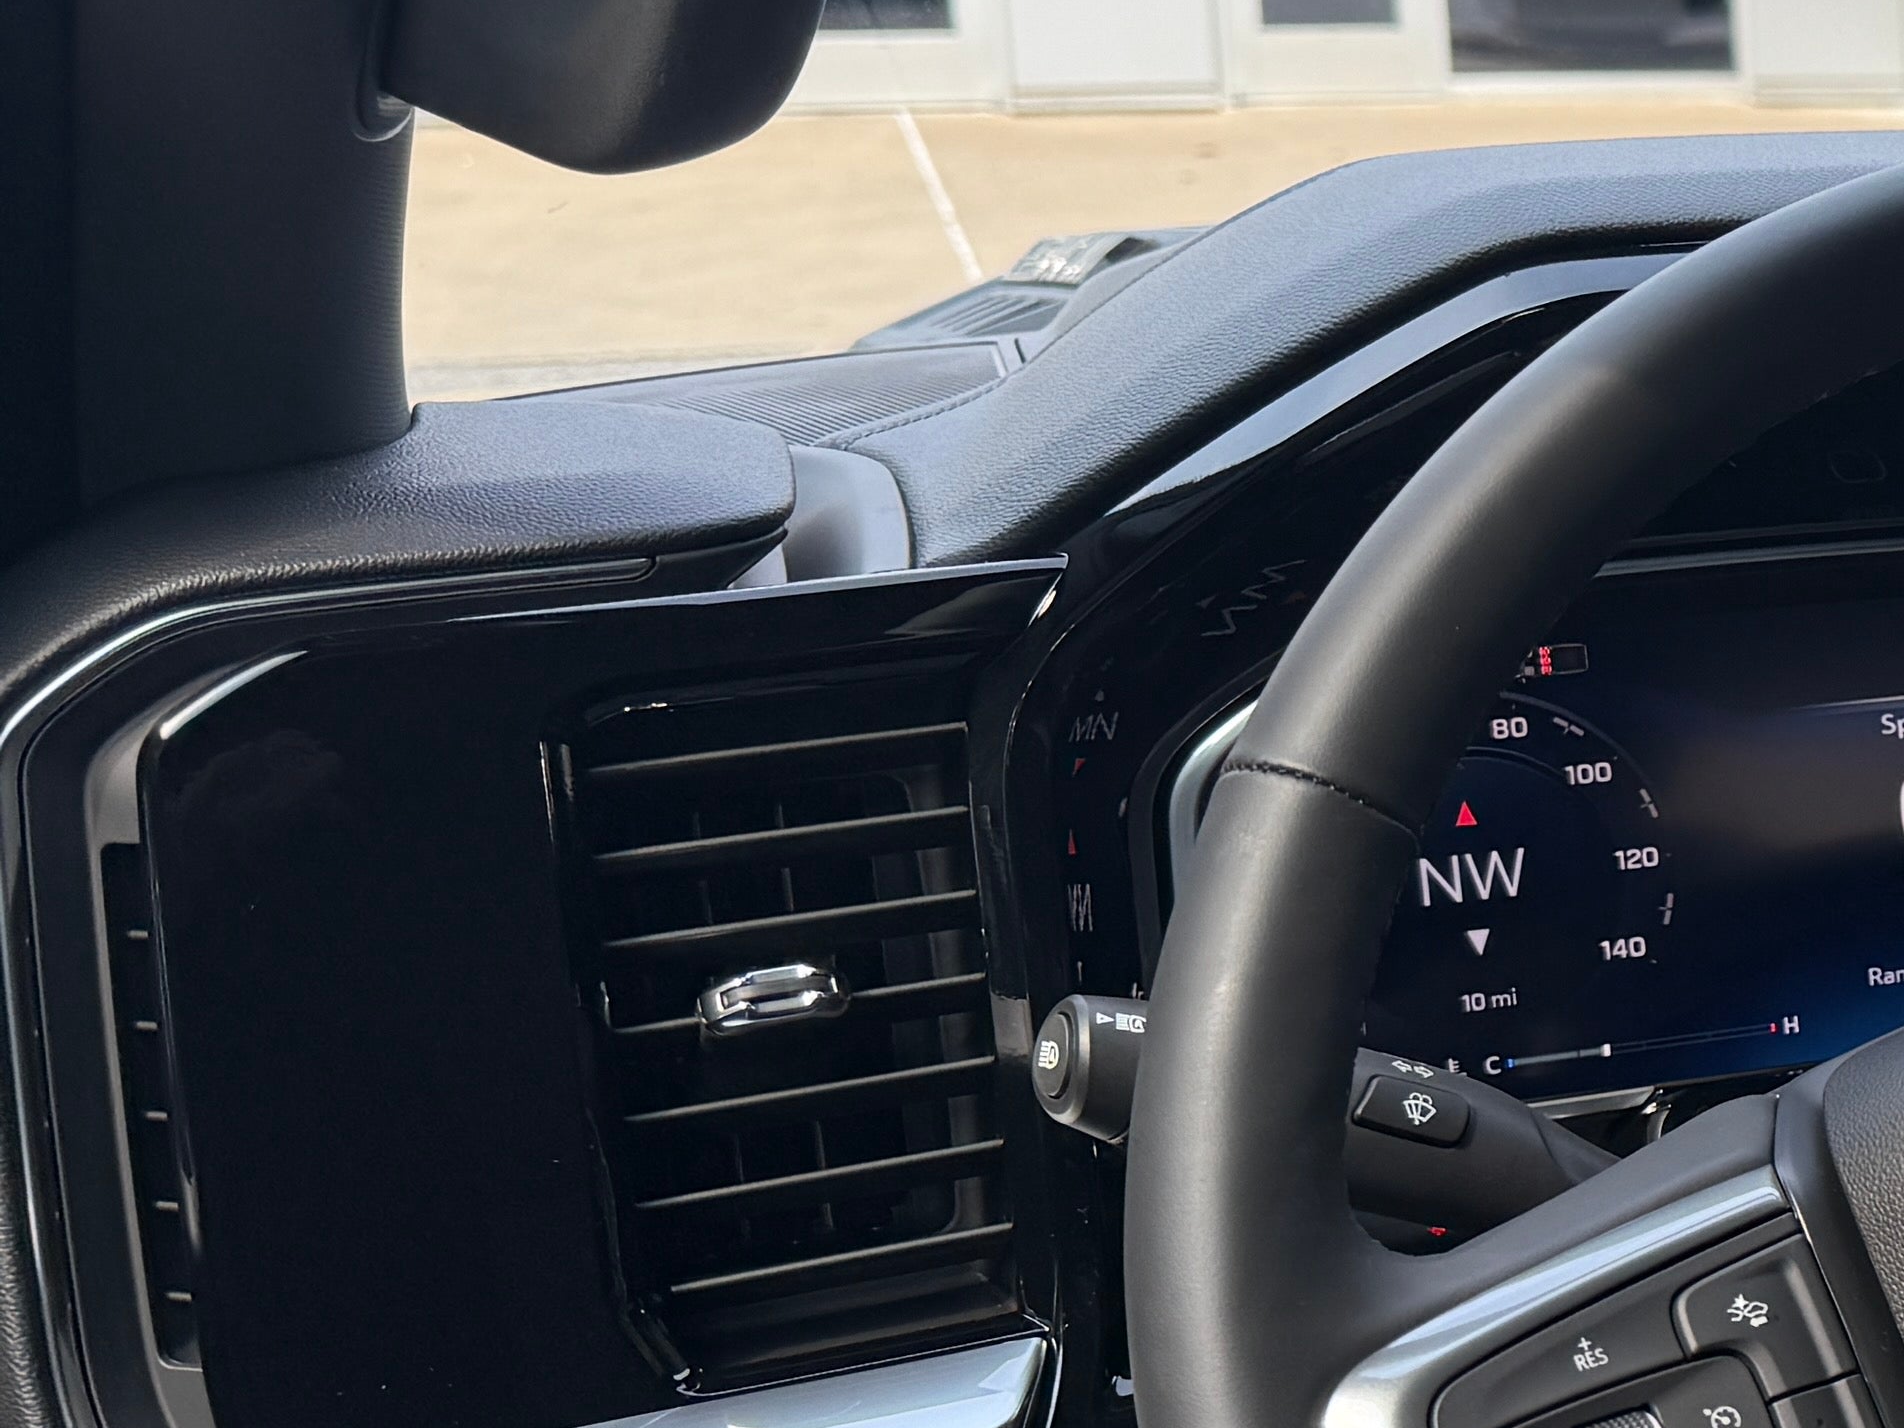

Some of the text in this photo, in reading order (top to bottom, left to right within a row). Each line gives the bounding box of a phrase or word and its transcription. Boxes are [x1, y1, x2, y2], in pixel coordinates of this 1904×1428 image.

[1490, 715, 1529, 740] 80
[1564, 761, 1613, 786] 100
[1614, 846, 1660, 871] 120
[1416, 846, 1525, 908] NW
[1599, 936, 1647, 961] 140
[1460, 987, 1519, 1013] 10 mi
[1781, 1015, 1801, 1035] H
[1484, 1056, 1504, 1076] C
[1573, 1348, 1610, 1372] RES
